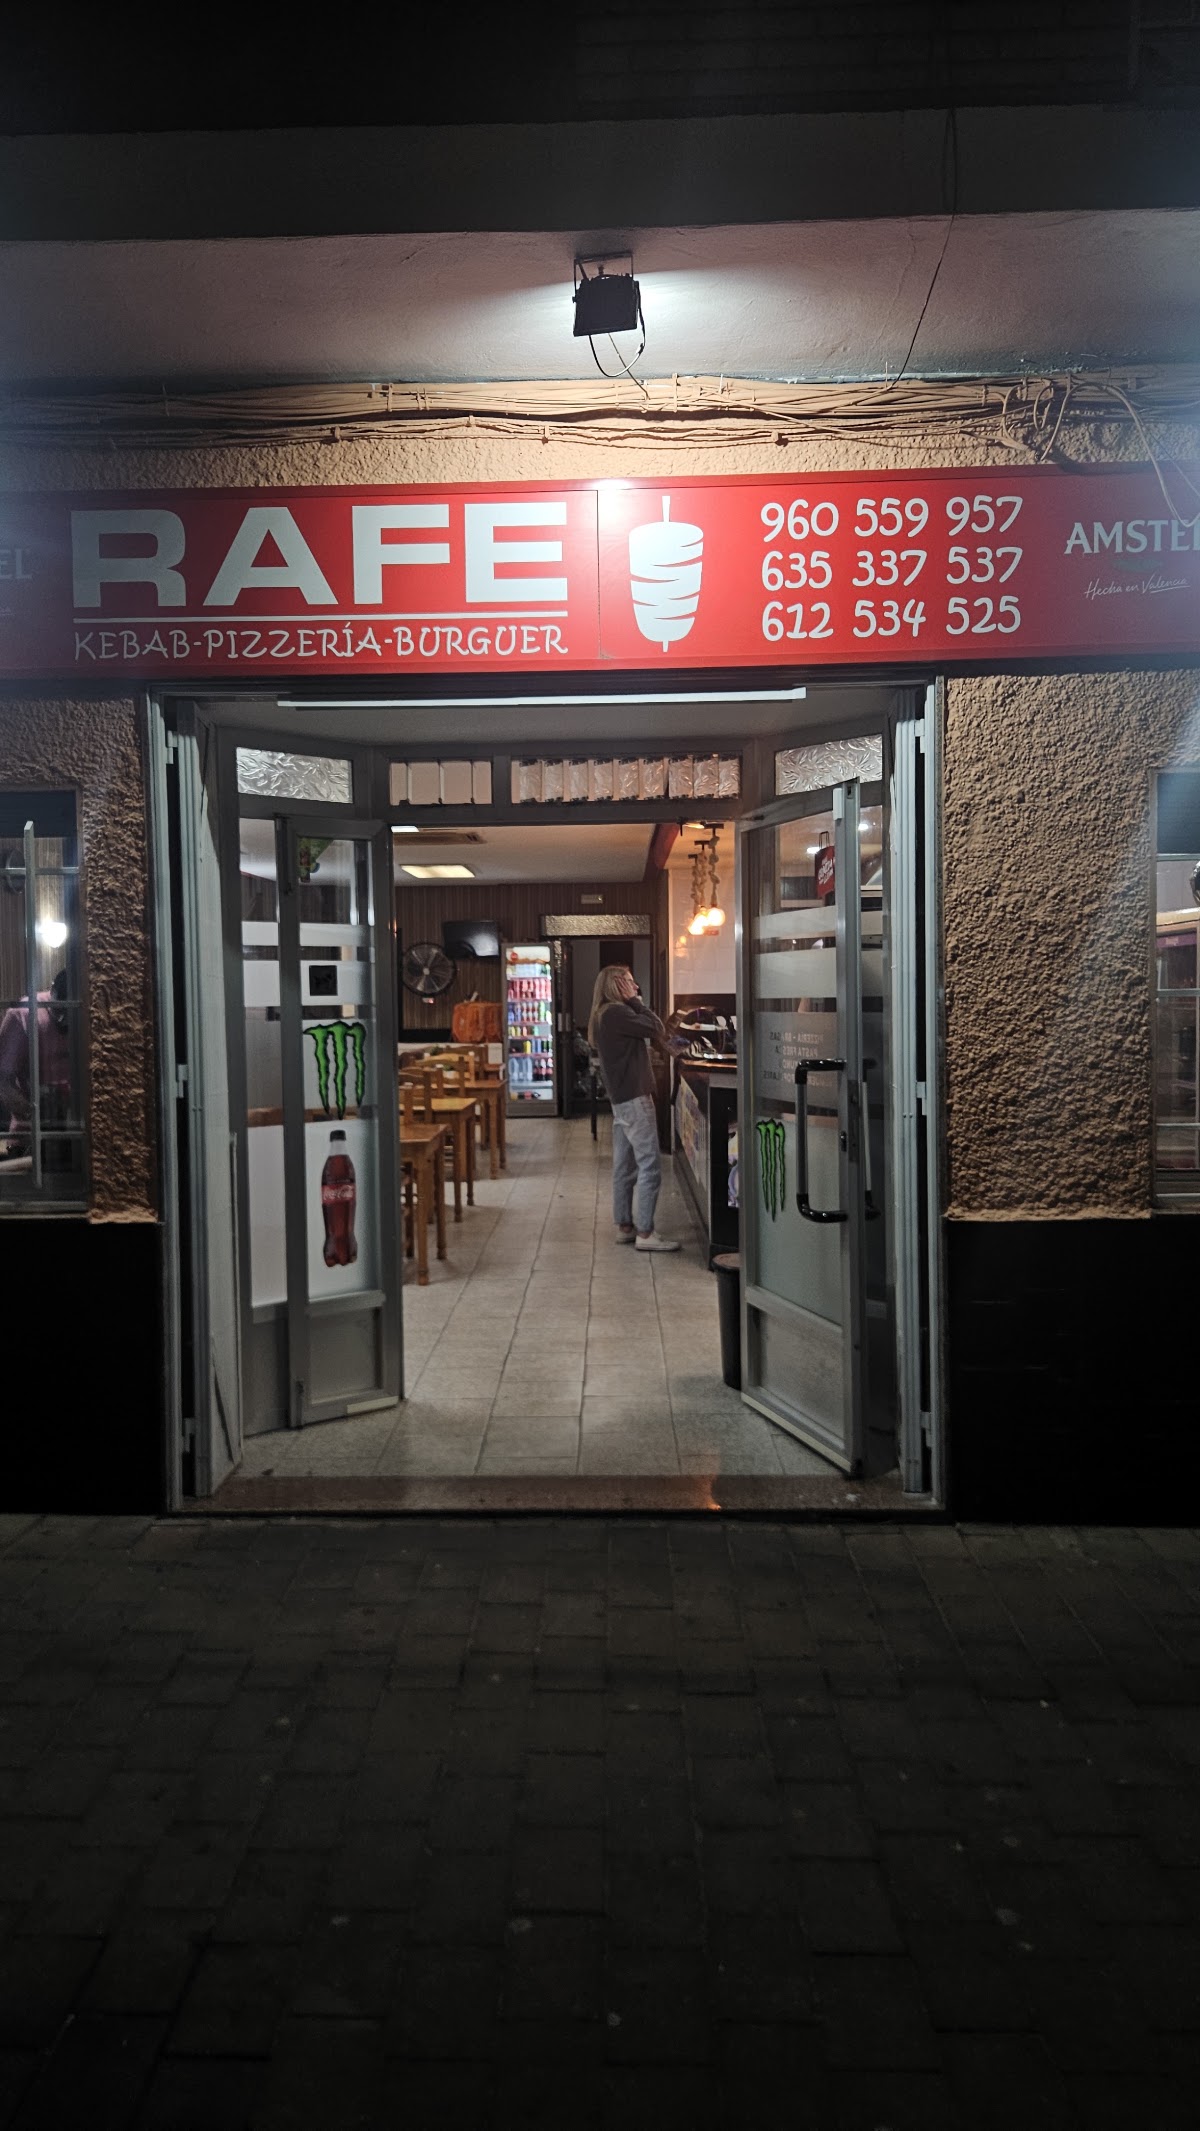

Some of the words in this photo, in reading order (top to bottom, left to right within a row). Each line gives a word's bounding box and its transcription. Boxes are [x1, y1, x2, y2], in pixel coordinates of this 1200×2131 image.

[761, 498, 840, 542] 960
[854, 497, 929, 537] 559
[945, 495, 1023, 536] 957
[71, 501, 568, 607] RAFE
[761, 549, 833, 591] 635
[851, 549, 928, 588] 337
[946, 546, 1023, 585] 537
[1083, 578, 1122, 600] Hecha
[1125, 585, 1139, 593] en
[1142, 572, 1189, 594] Valencia
[74, 622, 568, 661] KEBAB-PIZZERÍA-BURGUER
[761, 600, 834, 642] 612
[852, 598, 927, 637] 534
[945, 596, 1021, 634] 525
